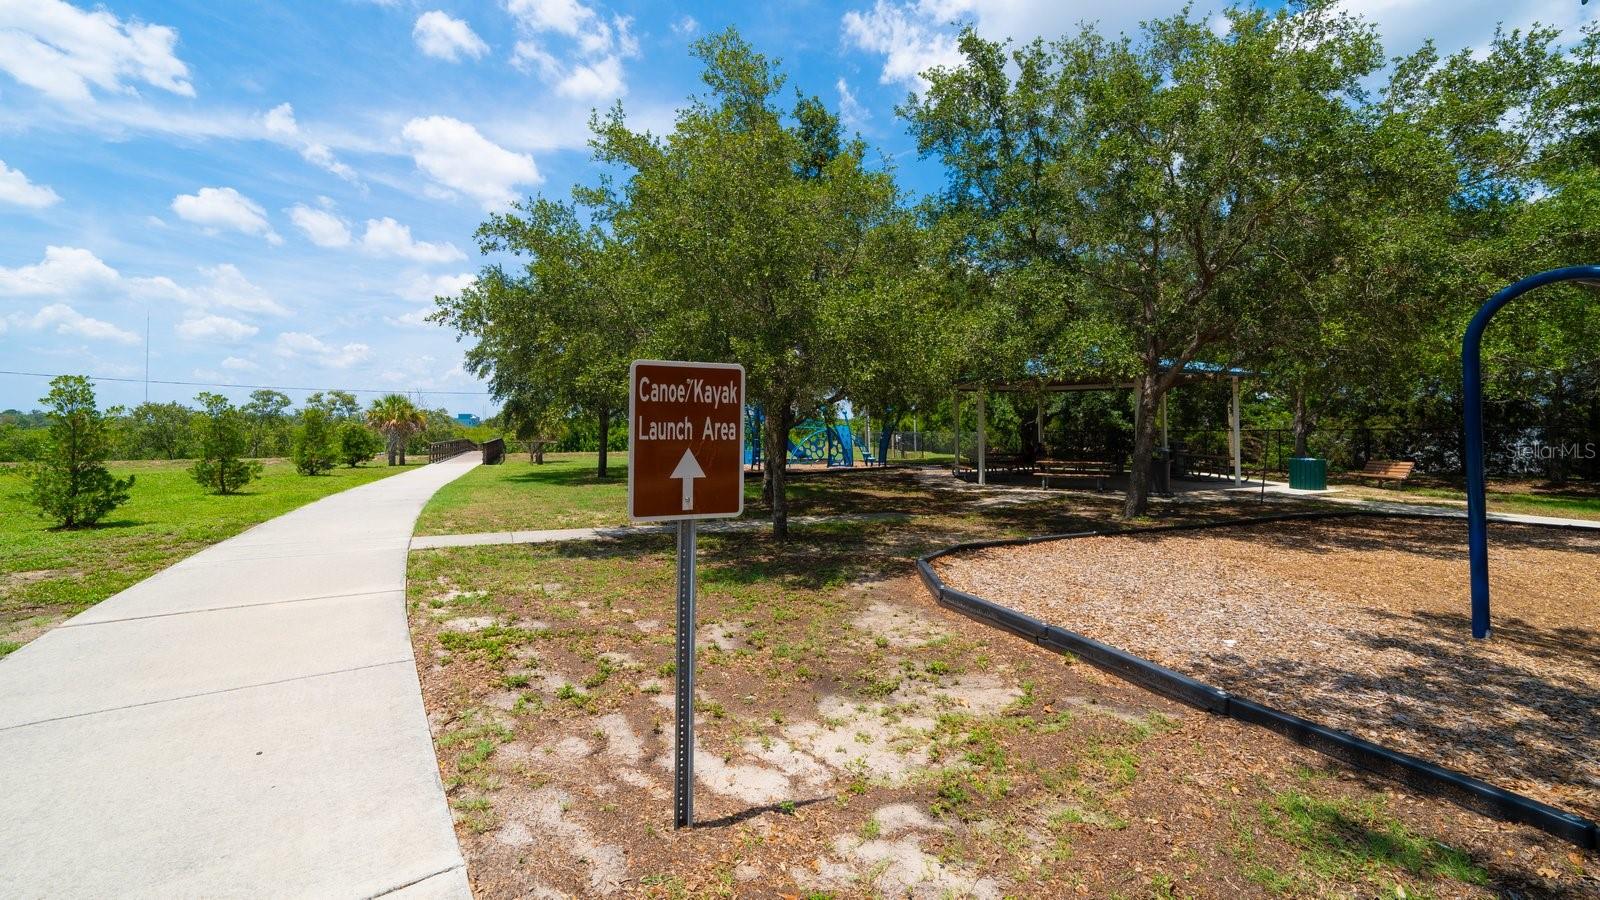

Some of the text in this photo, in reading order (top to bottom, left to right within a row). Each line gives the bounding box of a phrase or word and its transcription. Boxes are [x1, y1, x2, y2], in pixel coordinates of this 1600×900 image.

[639, 376, 738, 409] Canoe/Kayak
[639, 415, 736, 441] Launch Area
